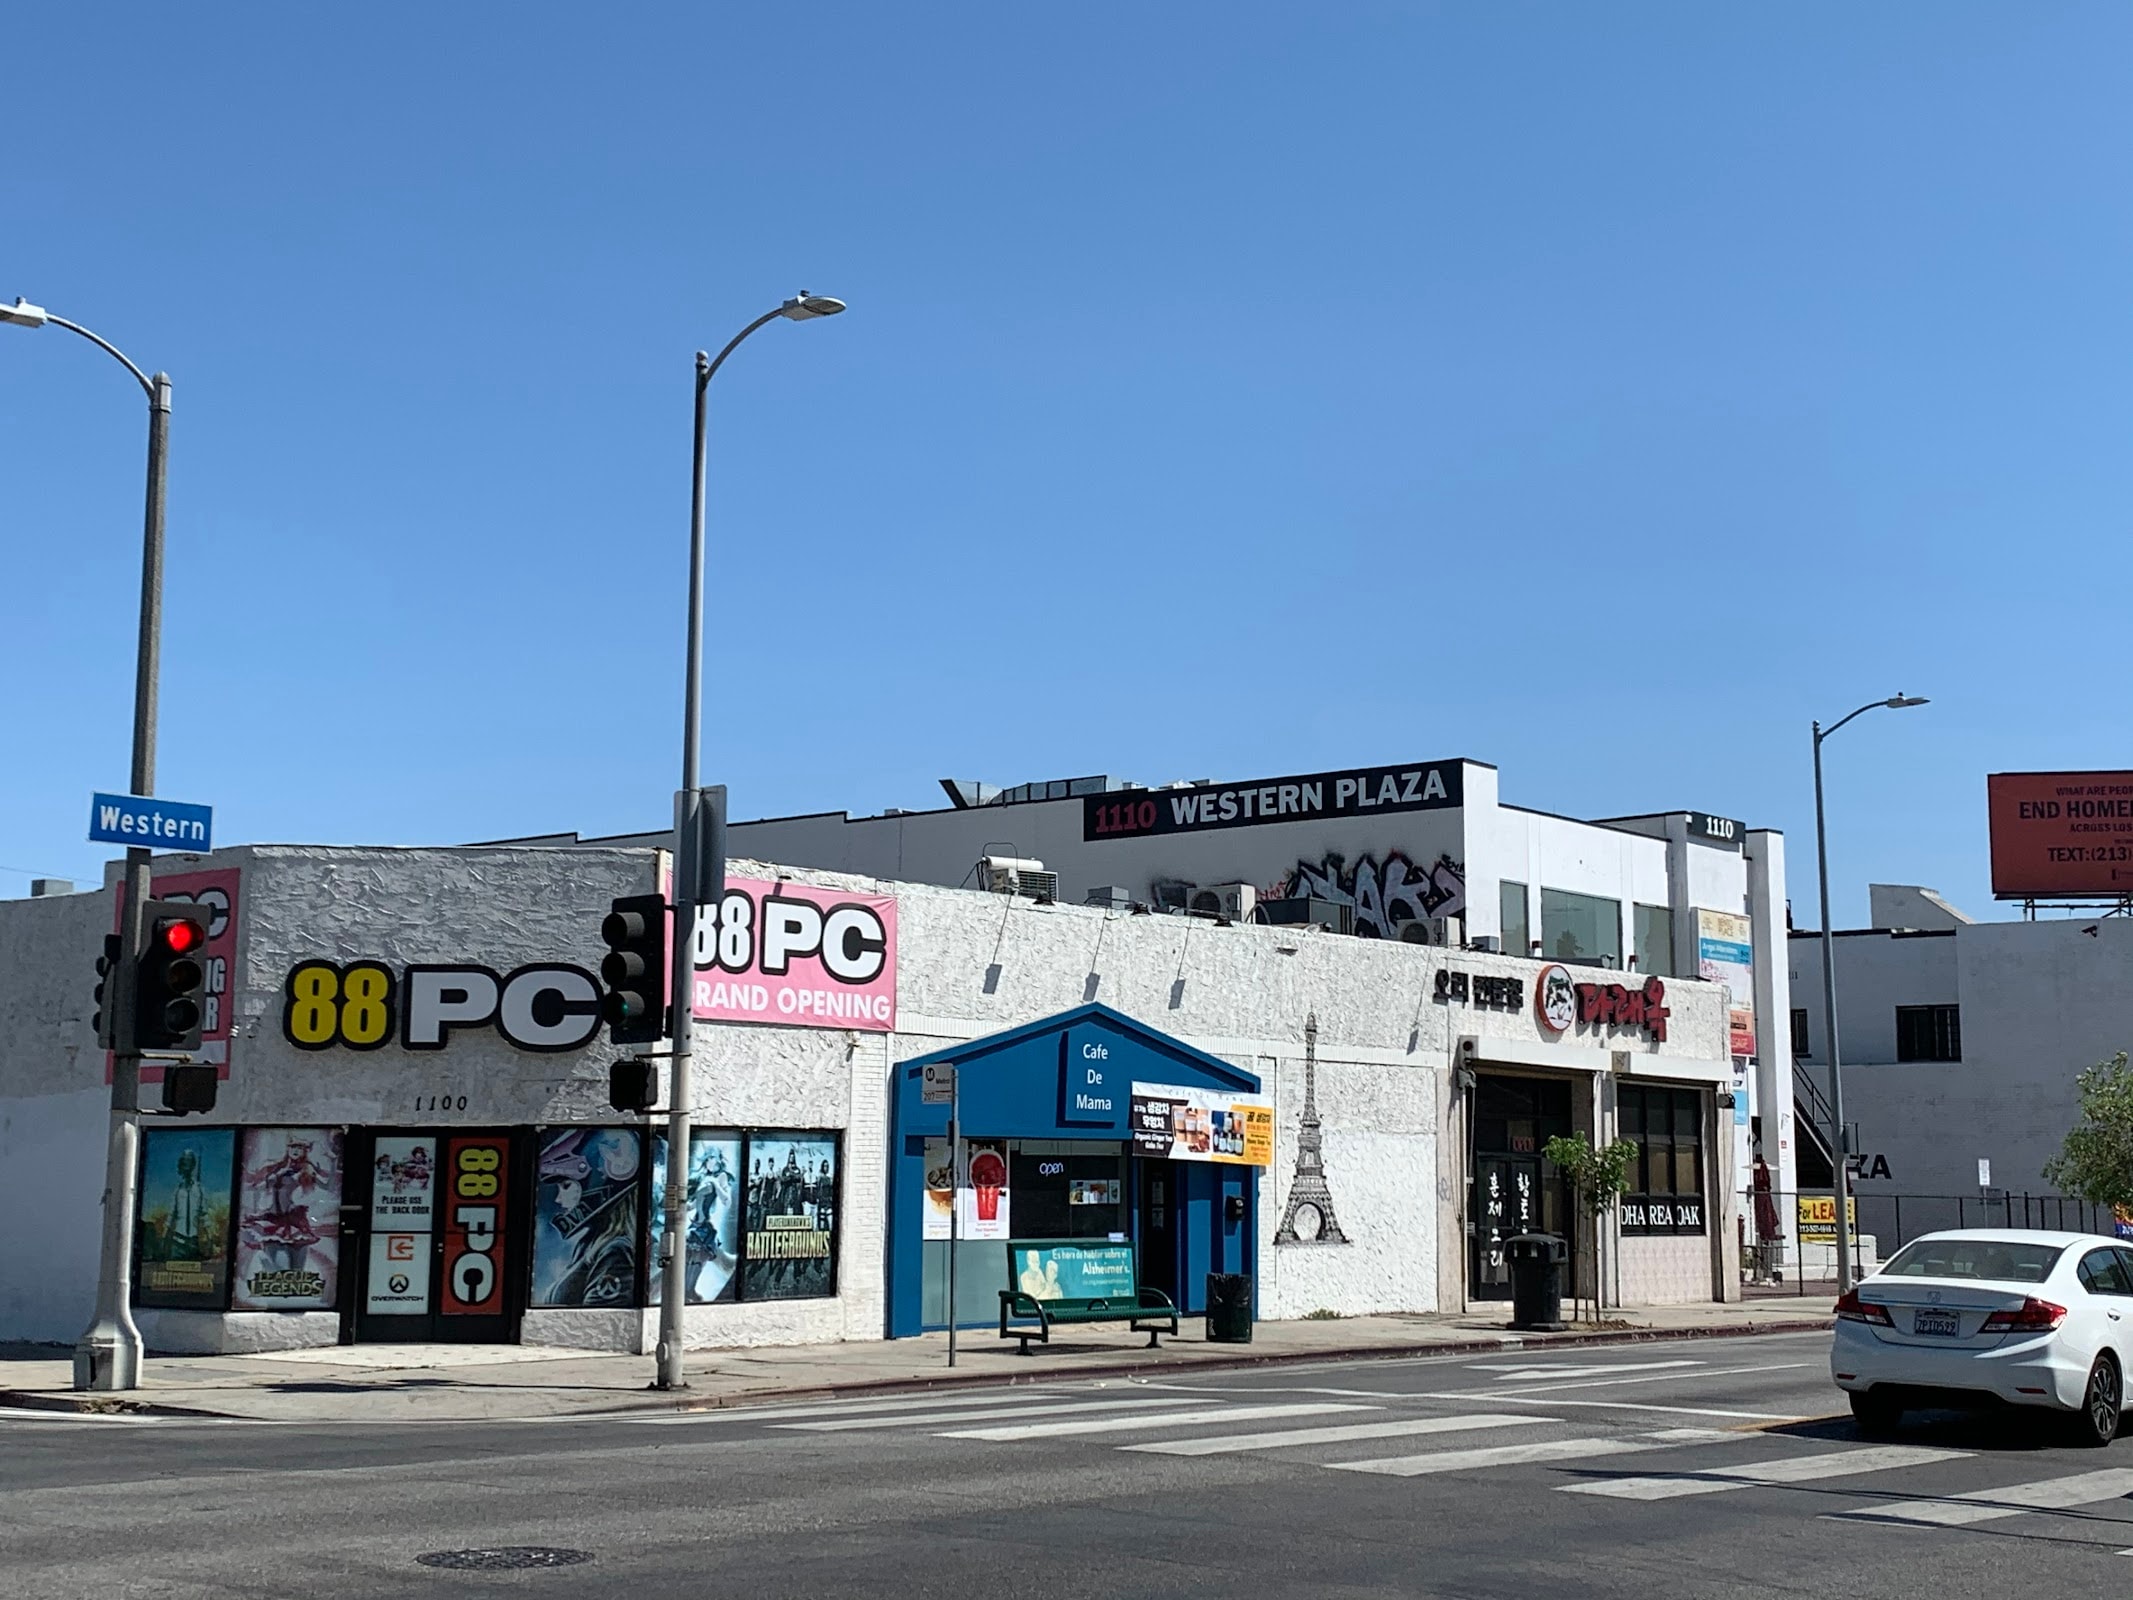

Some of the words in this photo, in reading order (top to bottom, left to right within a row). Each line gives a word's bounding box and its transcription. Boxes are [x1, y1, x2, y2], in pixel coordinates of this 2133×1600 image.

[2086, 786, 2106, 796] ARE
[1095, 801, 1157, 834] 1110
[1170, 781, 1324, 826] WESTERN
[1335, 769, 1448, 809] PLAZA
[2019, 801, 2060, 819] END
[99, 804, 206, 842] Western
[1706, 816, 1734, 840] 1110
[2070, 823, 2111, 833] ACROSS
[2113, 823, 2133, 832] LOS
[760, 895, 887, 985] PC
[1432, 968, 1470, 1003] 오리
[283, 959, 397, 1051] 88
[401, 963, 604, 1053] PC
[693, 981, 769, 1011] RAND
[777, 987, 891, 1021] OPENING
[1083, 1043, 1108, 1060] Cafe
[1087, 1070, 1103, 1085] De
[415, 1096, 468, 1112] 1100
[1076, 1096, 1112, 1111] Mama
[1147, 1101, 1170, 1116] 생강차
[455, 1144, 502, 1199] 88
[382, 1195, 407, 1205] PLEASE
[409, 1196, 423, 1205] USE
[375, 1206, 389, 1215] THE
[392, 1206, 410, 1215] BACK
[411, 1206, 430, 1215] DOOR
[1620, 1204, 1646, 1226] DHA
[1648, 1204, 1674, 1226] REA
[1676, 1205, 1701, 1226] OAK
[746, 1230, 830, 1260] BATTLEGROUNDS
[1051, 1249, 1061, 1260] Es
[1083, 1249, 1103, 1260] hablar
[1103, 1247, 1121, 1259] sobre
[451, 1204, 498, 1306] PC
[259, 1271, 313, 1283] LEAGUE
[249, 1279, 325, 1297] LEGENDS
